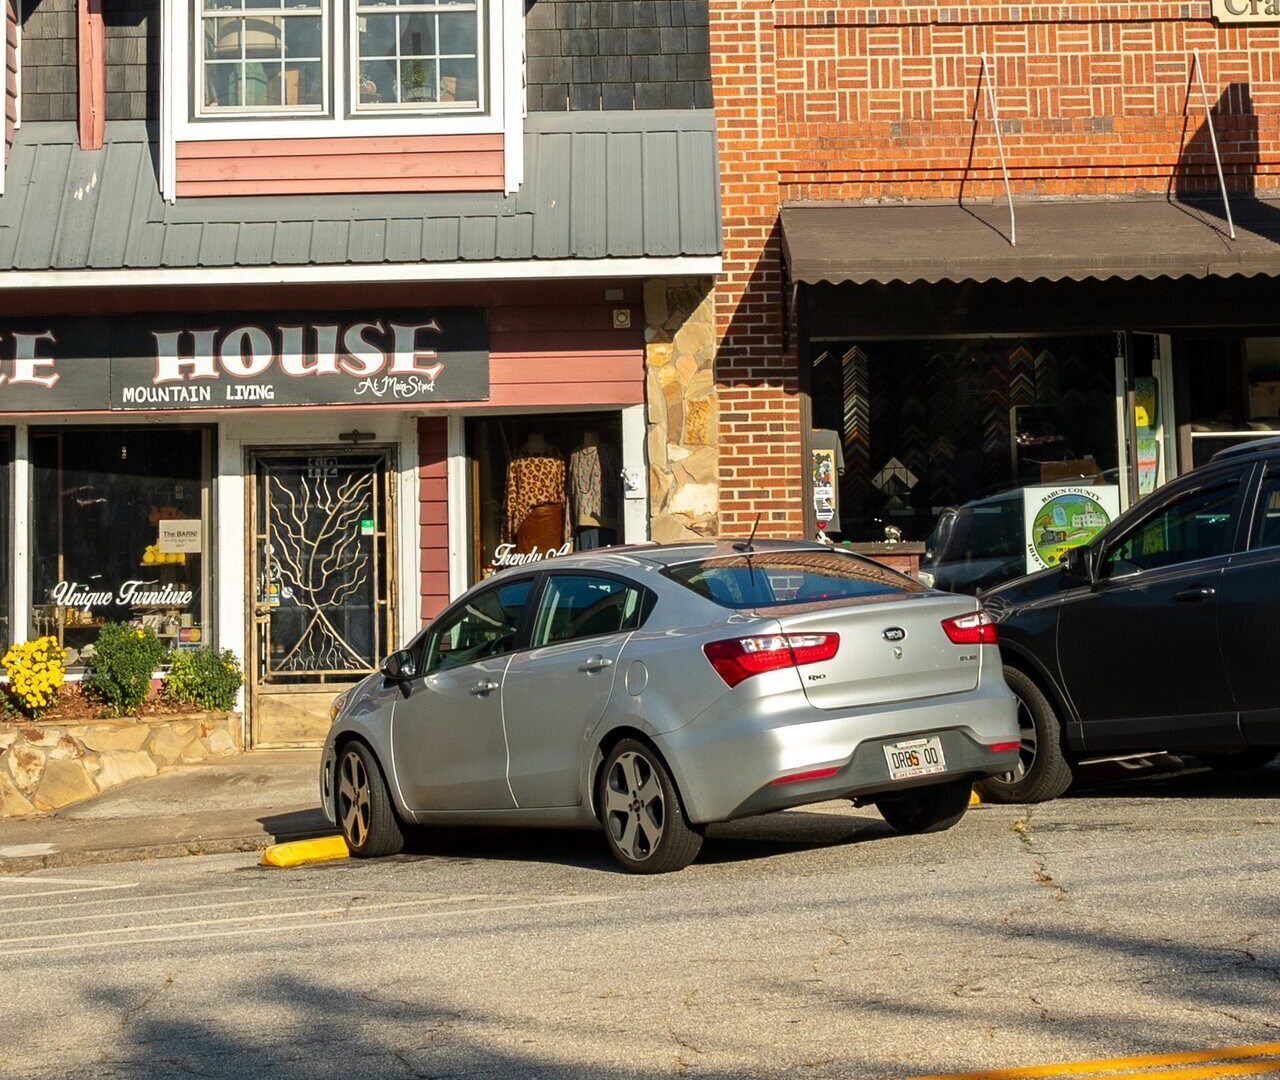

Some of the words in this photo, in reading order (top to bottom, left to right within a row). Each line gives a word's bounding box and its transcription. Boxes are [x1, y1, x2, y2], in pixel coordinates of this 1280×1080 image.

[151, 320, 445, 385] HOUSE
[122, 386, 211, 403] MOUNTAIN
[226, 384, 275, 401] LIVING
[1041, 488, 1066, 503] RABUN
[1068, 487, 1101, 501] COUNTY
[163, 530, 176, 538] The
[52, 581, 113, 612] Unique
[116, 580, 193, 606] Furniture
[891, 750, 919, 769] DRBS
